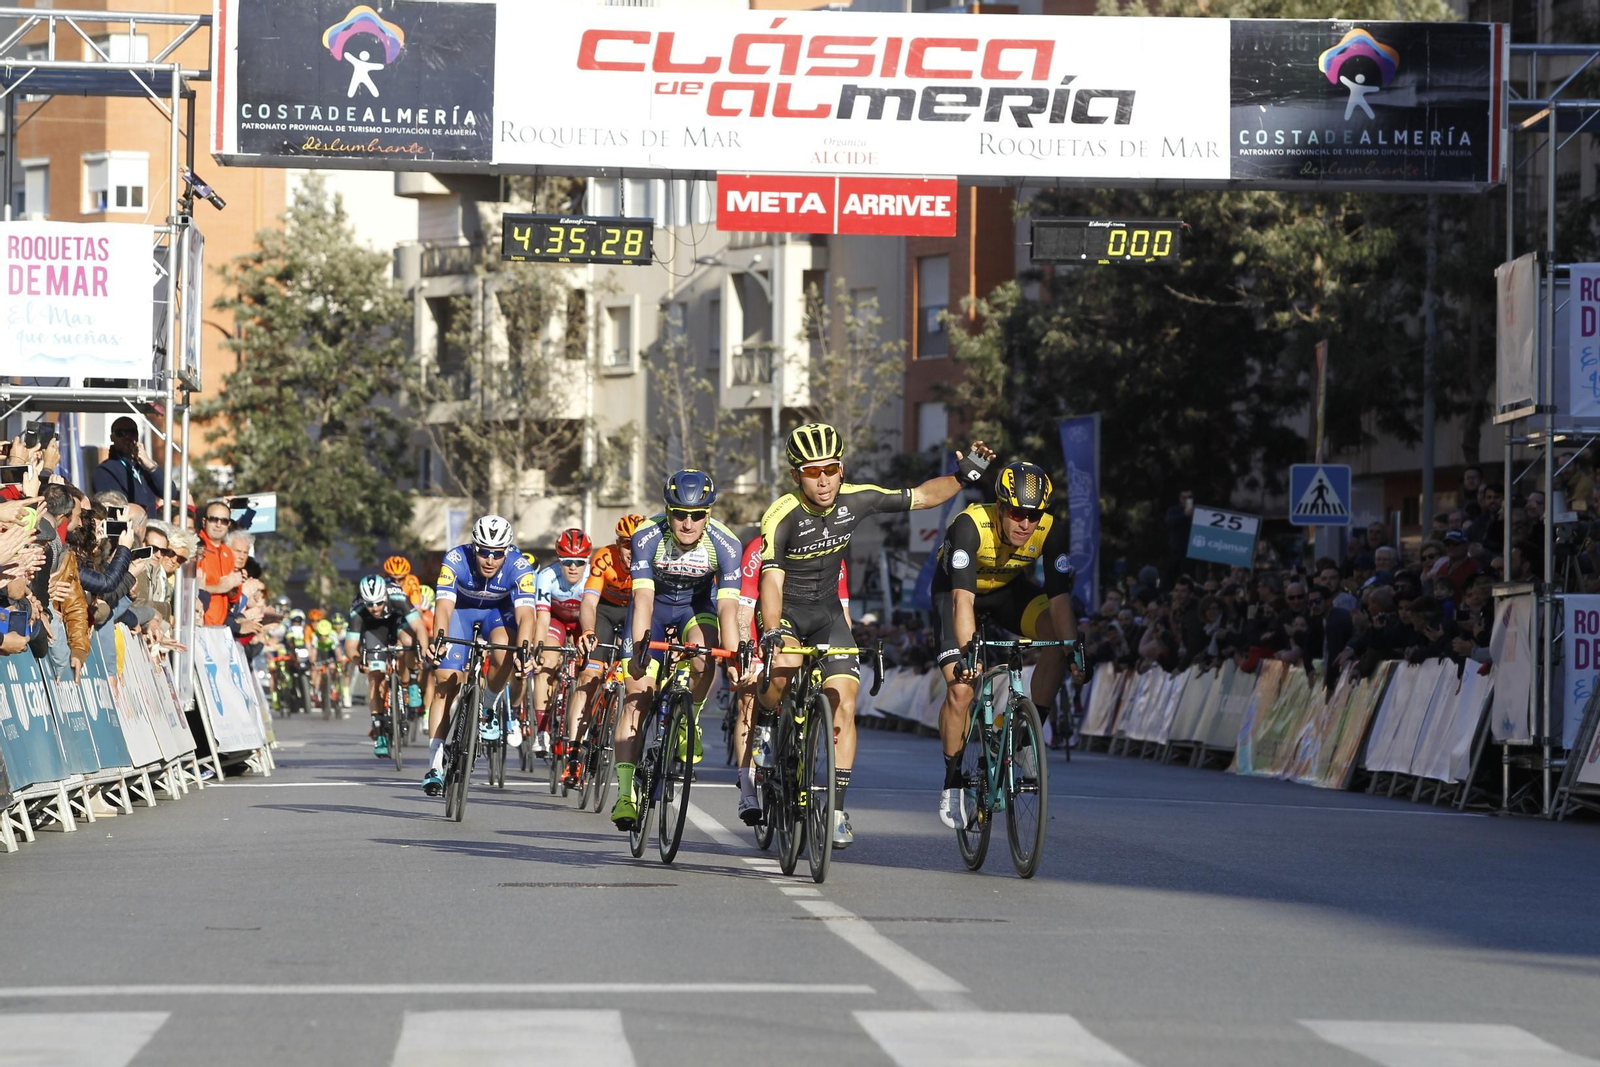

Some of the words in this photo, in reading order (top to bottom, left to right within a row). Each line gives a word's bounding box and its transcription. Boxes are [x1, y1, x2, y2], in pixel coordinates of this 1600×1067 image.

[654, 81, 704, 95] de
[241, 122, 287, 131] PATRONATO
[289, 124, 333, 132] PROVINCIAL
[348, 125, 382, 133] TURISMO
[384, 126, 430, 135] DIPUTACIÓN
[444, 127, 477, 136] ALMERÍA
[500, 120, 628, 149] ROQUETAS
[642, 128, 671, 147] DE
[683, 126, 742, 148] MAR
[302, 136, 427, 154] deslumbrante
[823, 136, 867, 148] Organiza
[979, 132, 1108, 161] ROQUETAS
[1120, 139, 1149, 158] DE
[1161, 136, 1221, 159] MAR
[1239, 148, 1285, 156] PATRONATO
[1286, 148, 1331, 156] PROVINCIAL
[1333, 148, 1343, 156] DE
[1345, 148, 1379, 156] TURISMO
[1440, 148, 1473, 157] ALMERÍA
[810, 151, 880, 165] ALCIDE
[726, 190, 827, 214] META
[842, 193, 952, 218] ARRIVEE
[8, 235, 109, 261] ROQUETAS
[513, 226, 644, 257] 4.35.28
[40, 304, 97, 329] Mar
[53, 330, 123, 346] sueñas
[763, 497, 793, 526] MITCHELTON
[1209, 512, 1243, 531] 25
[637, 526, 662, 550] Santic
[711, 529, 738, 559] startpeople
[788, 532, 853, 553] MITCHELTO
[1208, 540, 1248, 553] cajamar
[590, 552, 612, 578] CCC
